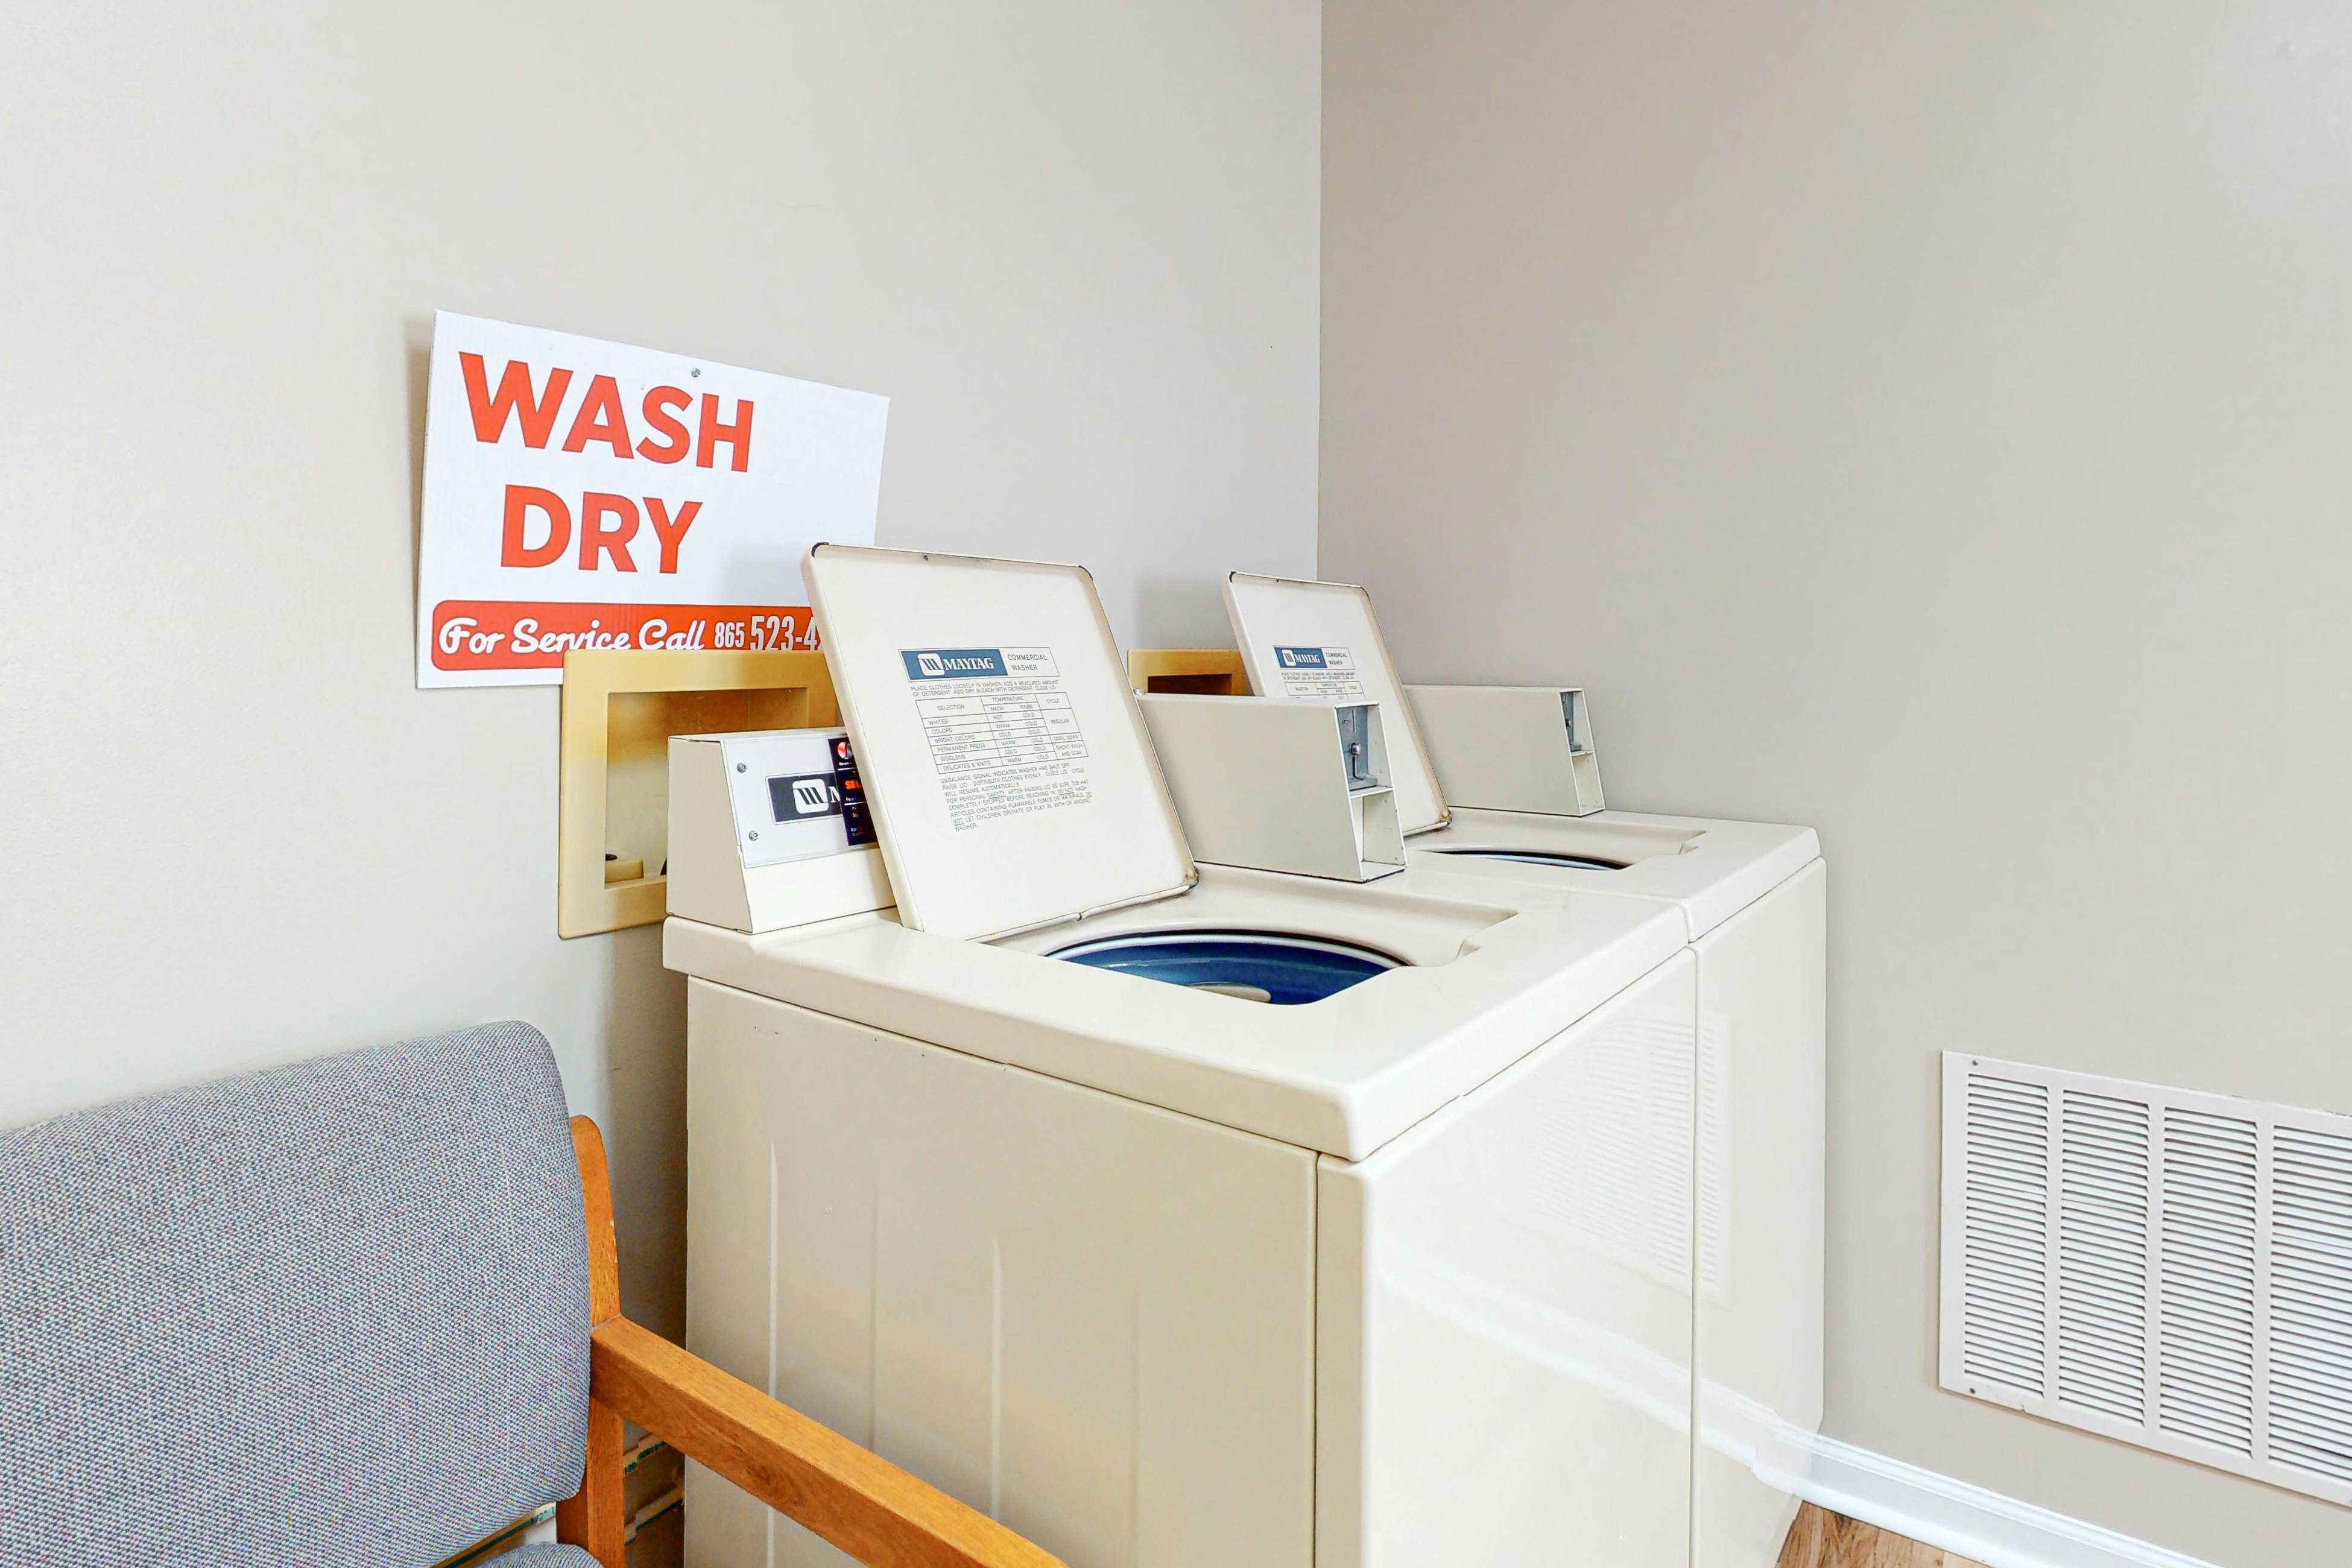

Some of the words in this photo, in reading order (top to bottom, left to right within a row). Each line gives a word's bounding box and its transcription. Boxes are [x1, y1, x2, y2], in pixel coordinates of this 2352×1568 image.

[458, 351, 754, 472] WASH
[501, 484, 703, 574] DRY
[439, 617, 505, 654] For
[511, 618, 631, 653] Service
[639, 619, 706, 650] Call
[714, 622, 745, 648] 865
[750, 616, 823, 650] 523-4
[943, 657, 994, 671] MAYTAG
[1294, 654, 1320, 663] MAYTAG
